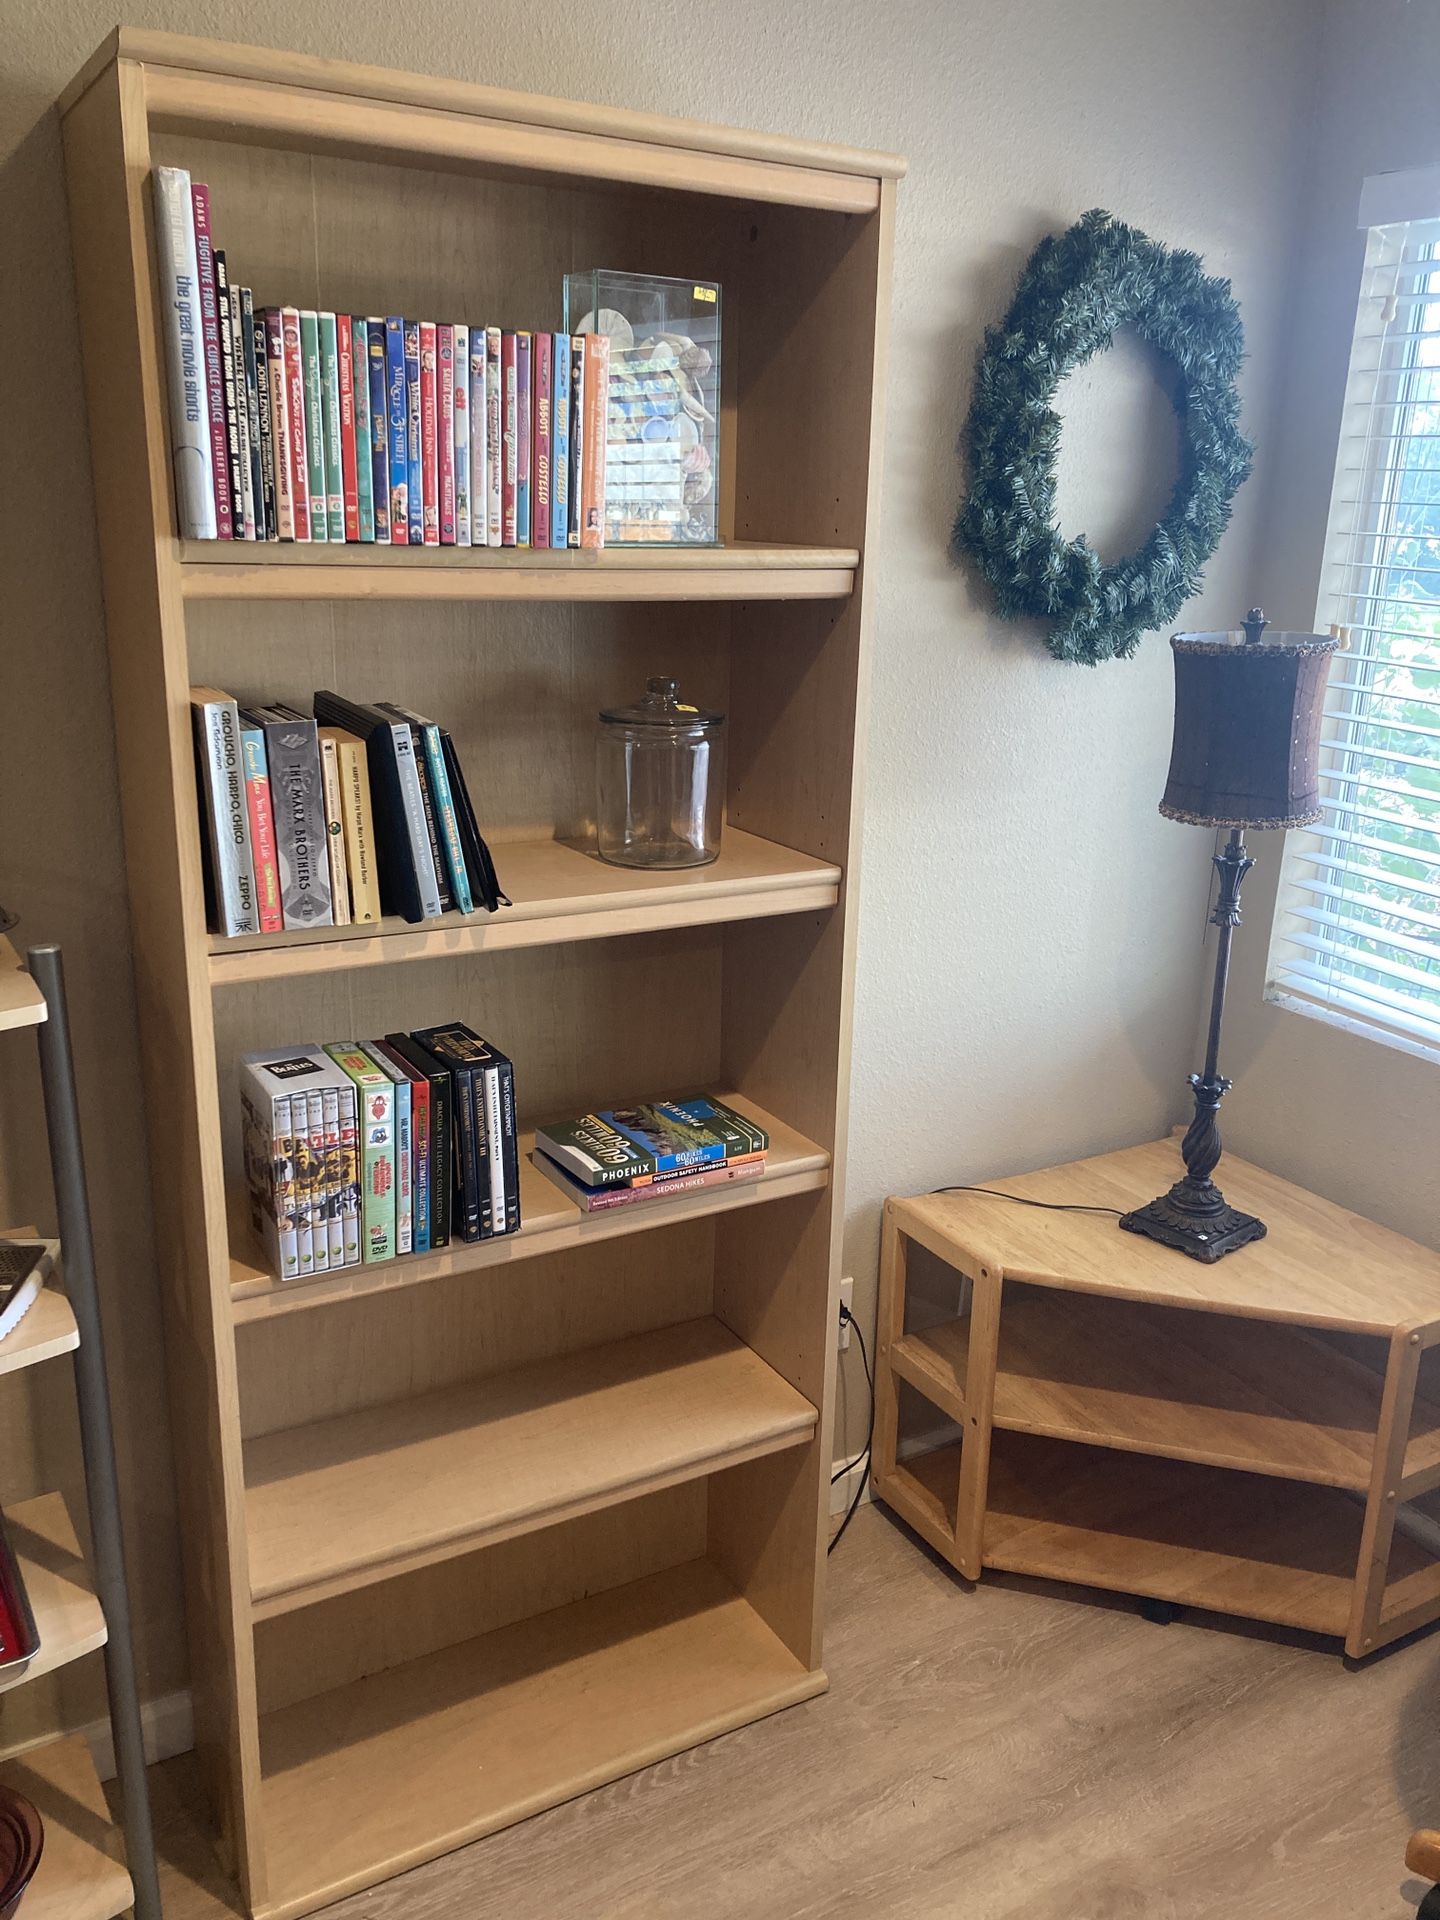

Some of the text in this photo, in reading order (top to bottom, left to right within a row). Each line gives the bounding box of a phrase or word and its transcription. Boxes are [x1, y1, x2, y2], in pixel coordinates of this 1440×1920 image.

[195, 194, 206, 228] ADAMS
[218, 262, 227, 288] ADAMS
[198, 234, 223, 424] FUGITIVE FROM THE CUBICLE POLICE
[174, 275, 200, 423] the great movie shorts
[327, 355, 335, 368] The
[219, 296, 240, 455] STILL PUMPED FROM USING THE MOUSE
[442, 368, 452, 392] SANTA
[257, 363, 271, 432] JOHN LENNON
[443, 394, 452, 419] CLAUS
[455, 387, 467, 411] elf
[311, 401, 320, 437] Christmas
[330, 401, 338, 436] Christmas
[391, 366, 405, 465] MIRACLE STREET
[425, 397, 435, 454] HOLIDAY INN
[215, 436, 225, 463] DILBERT
[313, 438, 321, 467] Classics
[539, 398, 549, 505] ABBOTT COSTELLO
[557, 399, 567, 505] ABBOTT COSTELLO
[278, 431, 288, 496] THANKSGIVING
[218, 478, 228, 502] BOOK
[221, 711, 236, 770] GROUCHO,
[290, 764, 302, 783] THE
[352, 767, 360, 783] HARPO
[404, 769, 412, 781] THE
[227, 771, 240, 813] HARPO,
[353, 784, 361, 804] SPEAKS!
[407, 783, 417, 808] BEATLES
[291, 788, 306, 824] MARX
[232, 814, 244, 845] CHICO
[256, 798, 271, 859] You Bet Your Life
[413, 818, 421, 835] HARD
[424, 792, 443, 885] THE MEN BEHIND THE MAYHEM
[295, 829, 311, 890] BROTHERS
[238, 875, 252, 911] ZEPPO
[271, 1061, 313, 1073] BEATLES
[475, 1078, 483, 1096] THAT'S
[503, 1076, 512, 1093] THAT'S
[476, 1097, 486, 1145] ENTERTAINMENT
[577, 1117, 608, 1138] MILES
[661, 1101, 704, 1127] PHOENIX
[418, 1140, 428, 1159] SCI-FI
[573, 1130, 629, 1164] 60 HIKES
[600, 1134, 631, 1150] 60
[653, 1172, 679, 1182] OUTDOOR
[679, 1168, 698, 1178] SAFETY
[698, 1161, 727, 1173] HANDBOOK
[675, 1153, 686, 1163] 60
[684, 1156, 695, 1166] 60
[420, 1160, 428, 1187] ULTIMATE
[602, 1163, 650, 1182] PHOENIX
[656, 1182, 684, 1195] SEDONA
[685, 1178, 705, 1190] HIKES
[420, 1188, 428, 1221] COLLECTION
